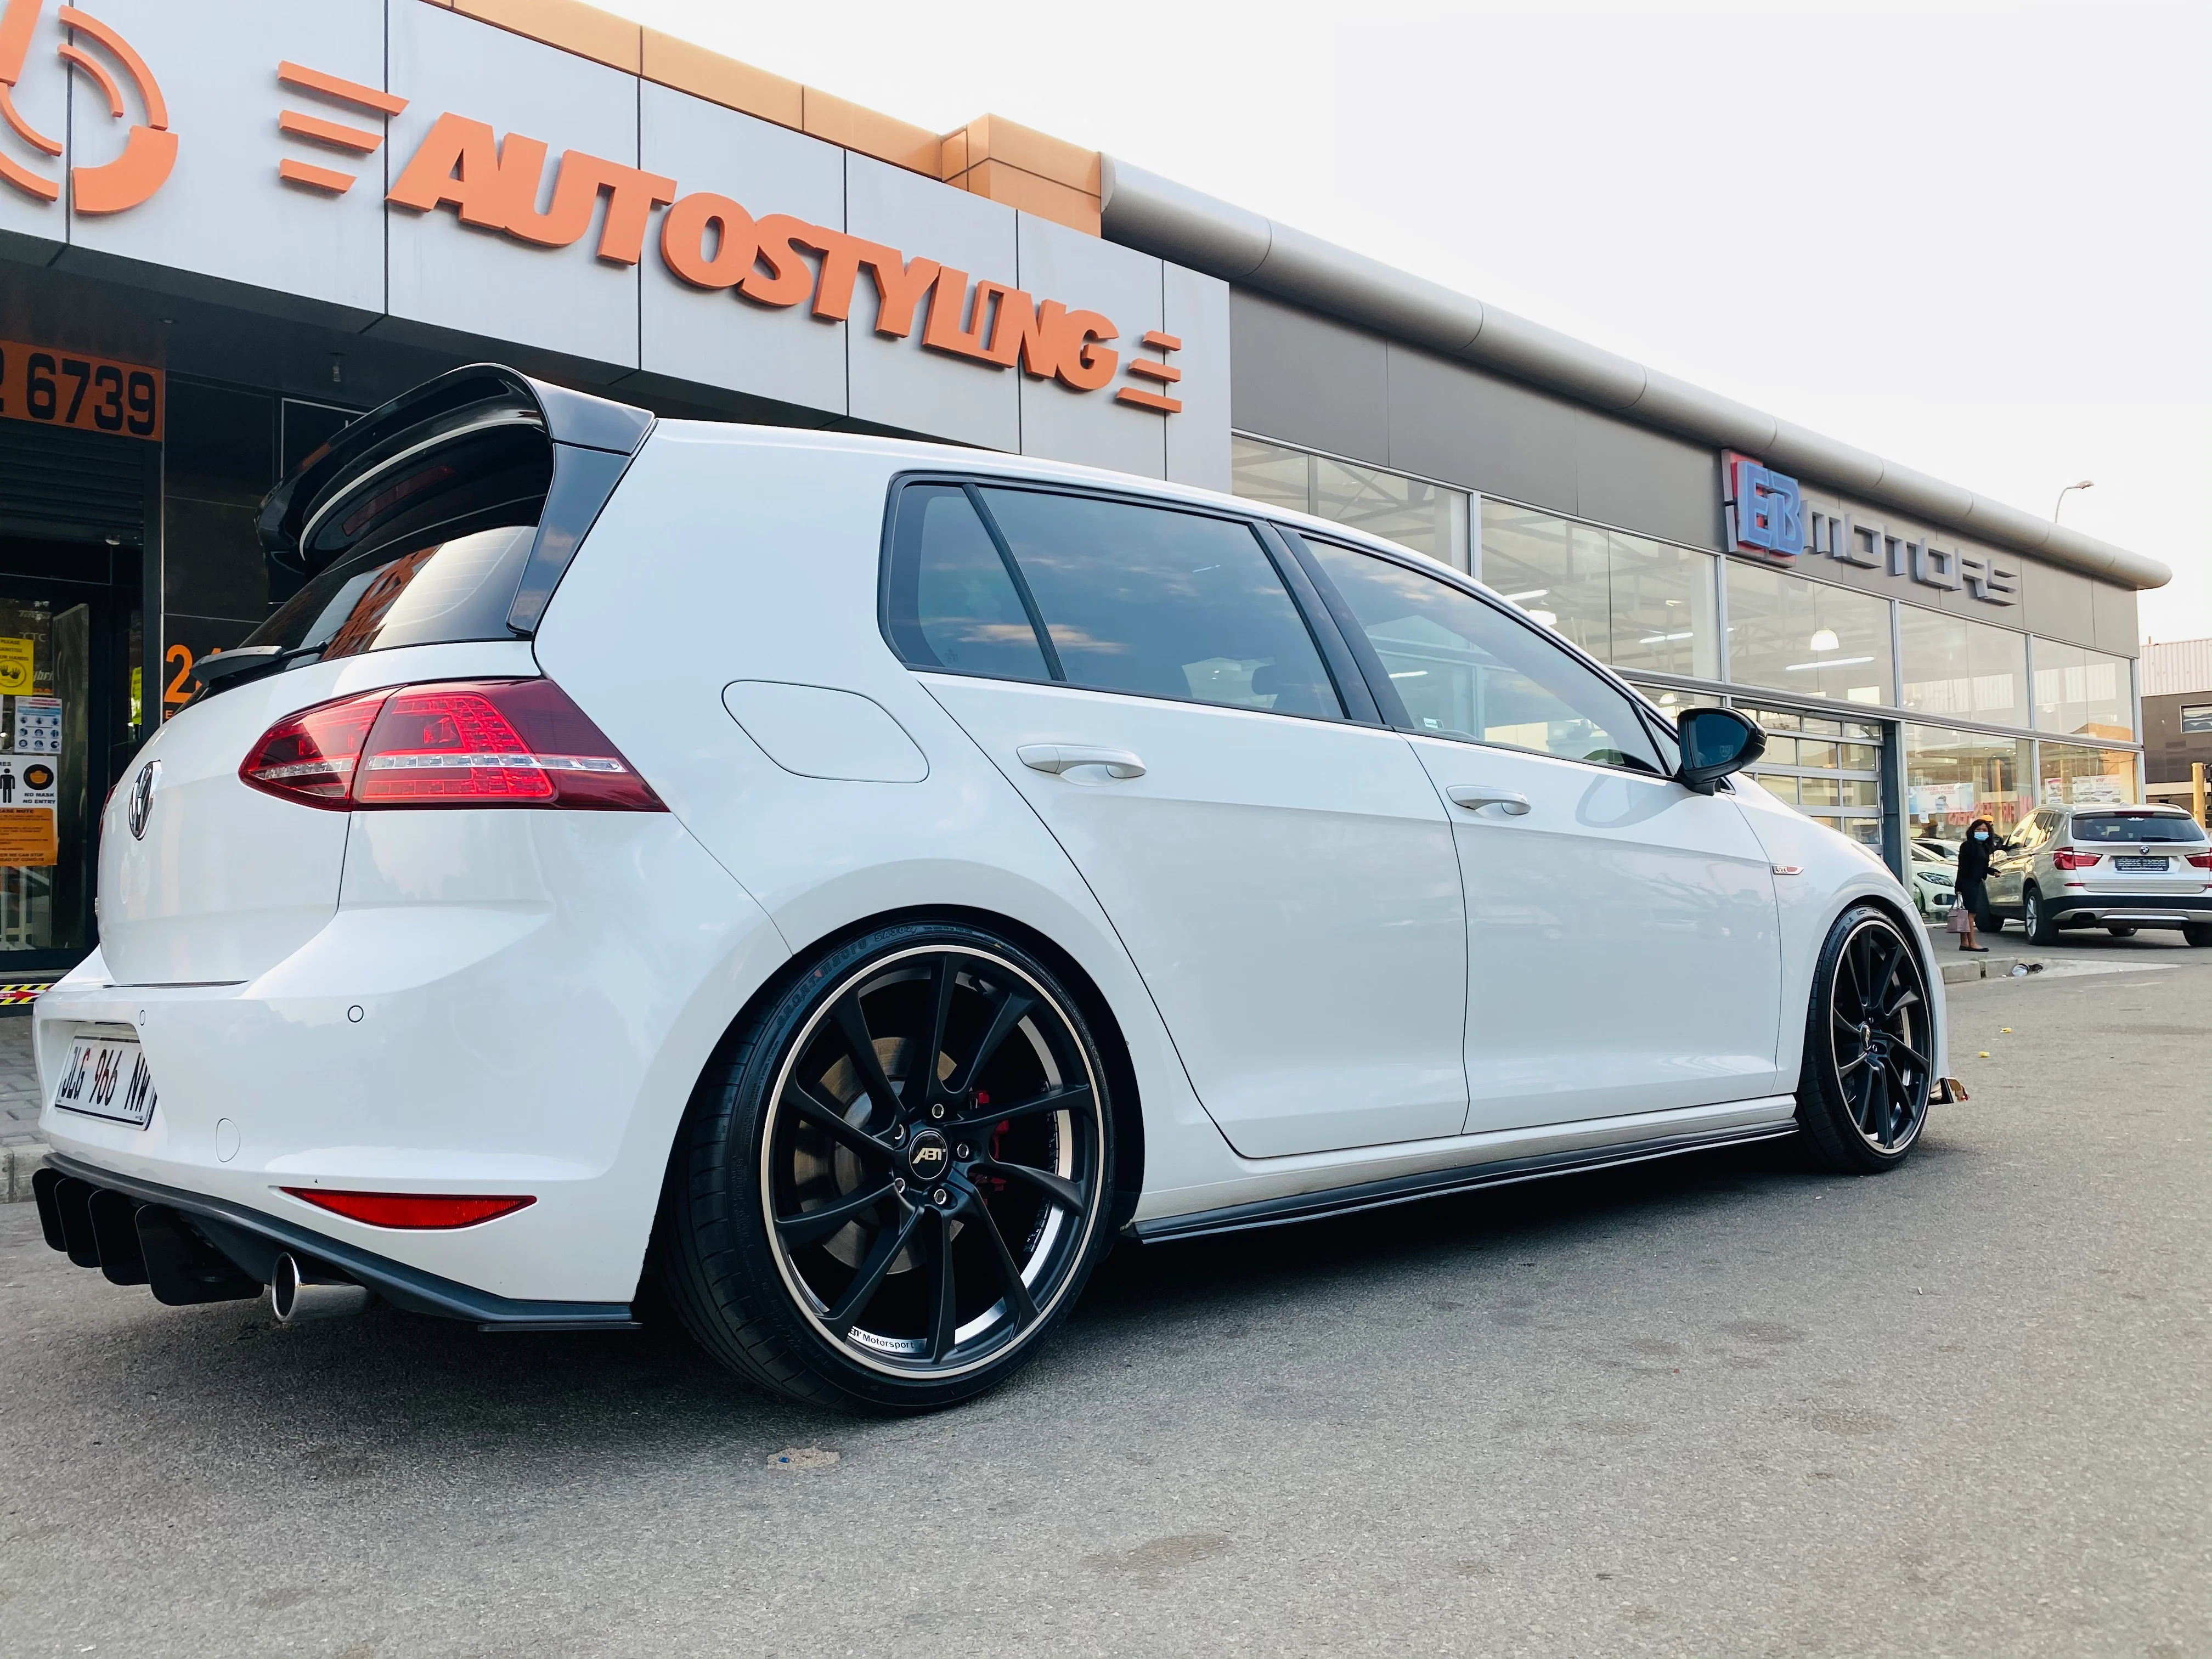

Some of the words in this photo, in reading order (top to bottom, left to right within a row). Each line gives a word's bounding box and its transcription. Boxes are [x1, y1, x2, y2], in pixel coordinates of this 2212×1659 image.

[385, 111, 1119, 392] AUTOSTYLING
[26, 352, 156, 436] 6739
[89, 1049, 123, 1106] 966
[912, 1147, 943, 1164] ABT
[863, 1333, 915, 1349] Motorsport
